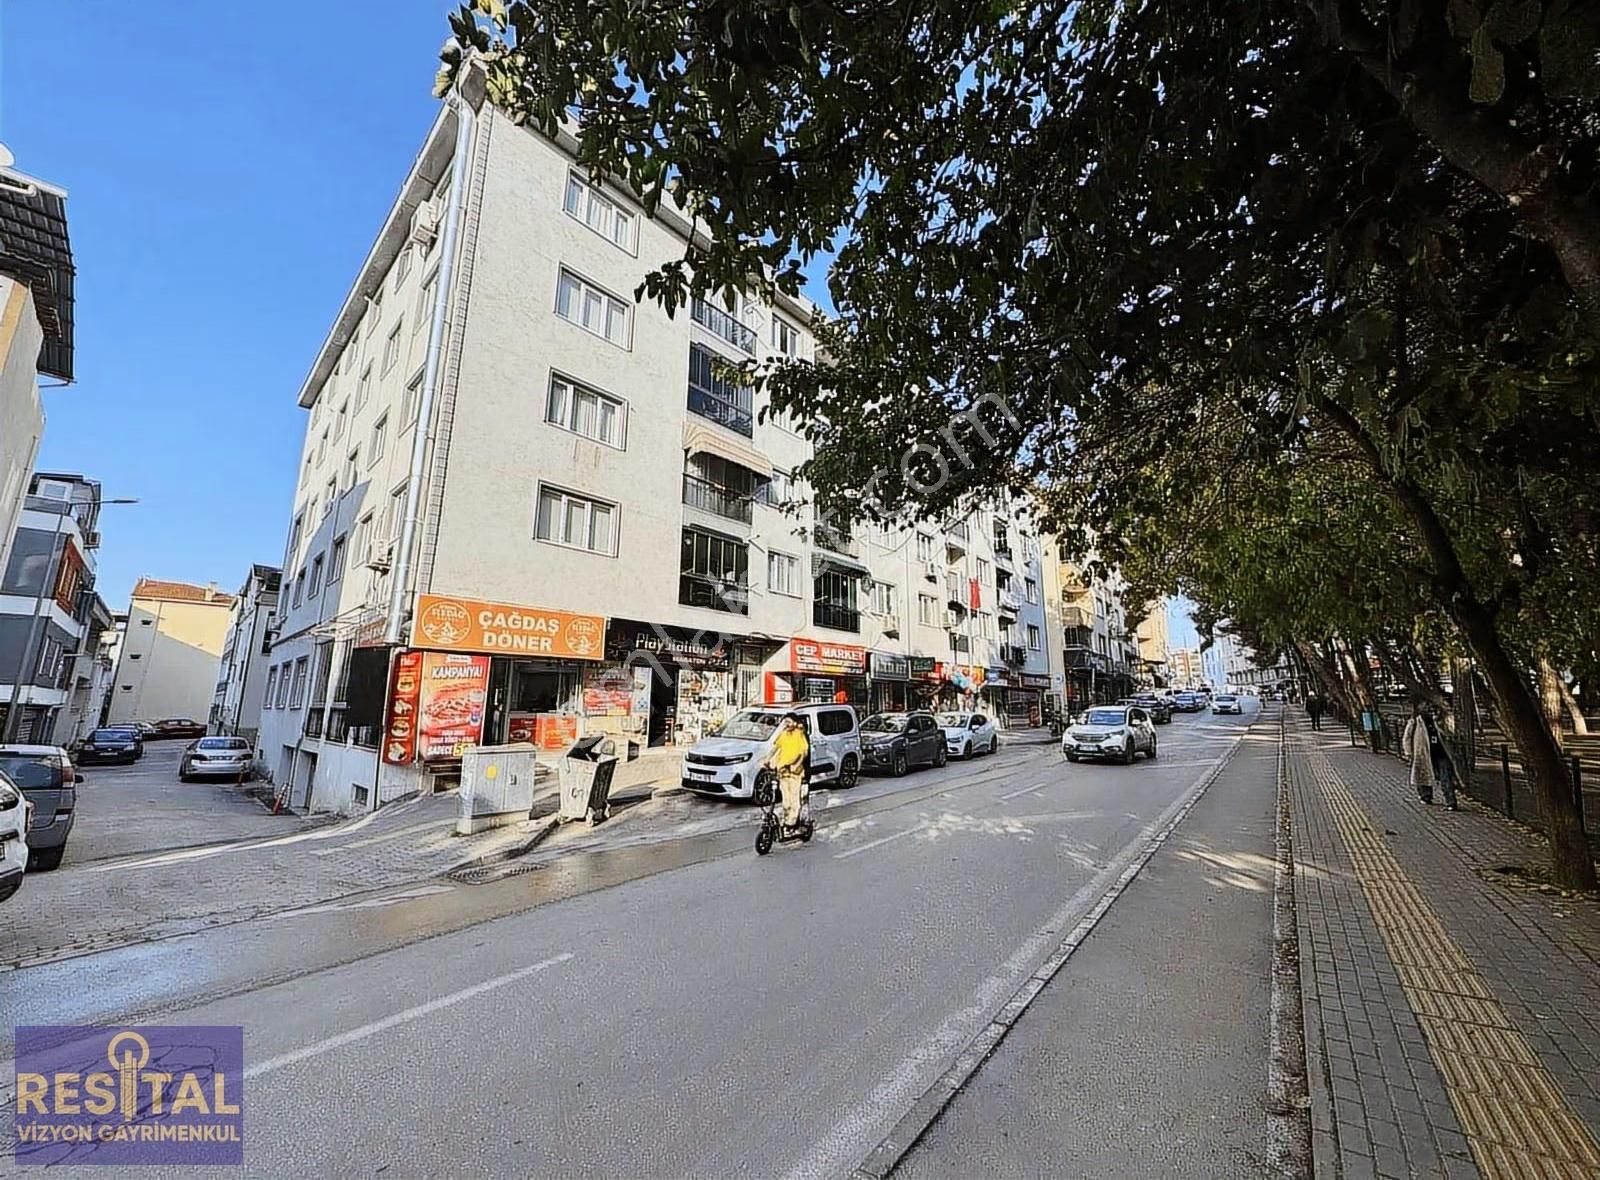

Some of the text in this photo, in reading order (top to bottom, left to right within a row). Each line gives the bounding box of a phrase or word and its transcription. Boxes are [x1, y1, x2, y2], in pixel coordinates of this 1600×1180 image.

[478, 610, 560, 637] ÇAĞDAŞ
[482, 629, 553, 651] DÖNER
[796, 645, 864, 660] CEP MARKET
